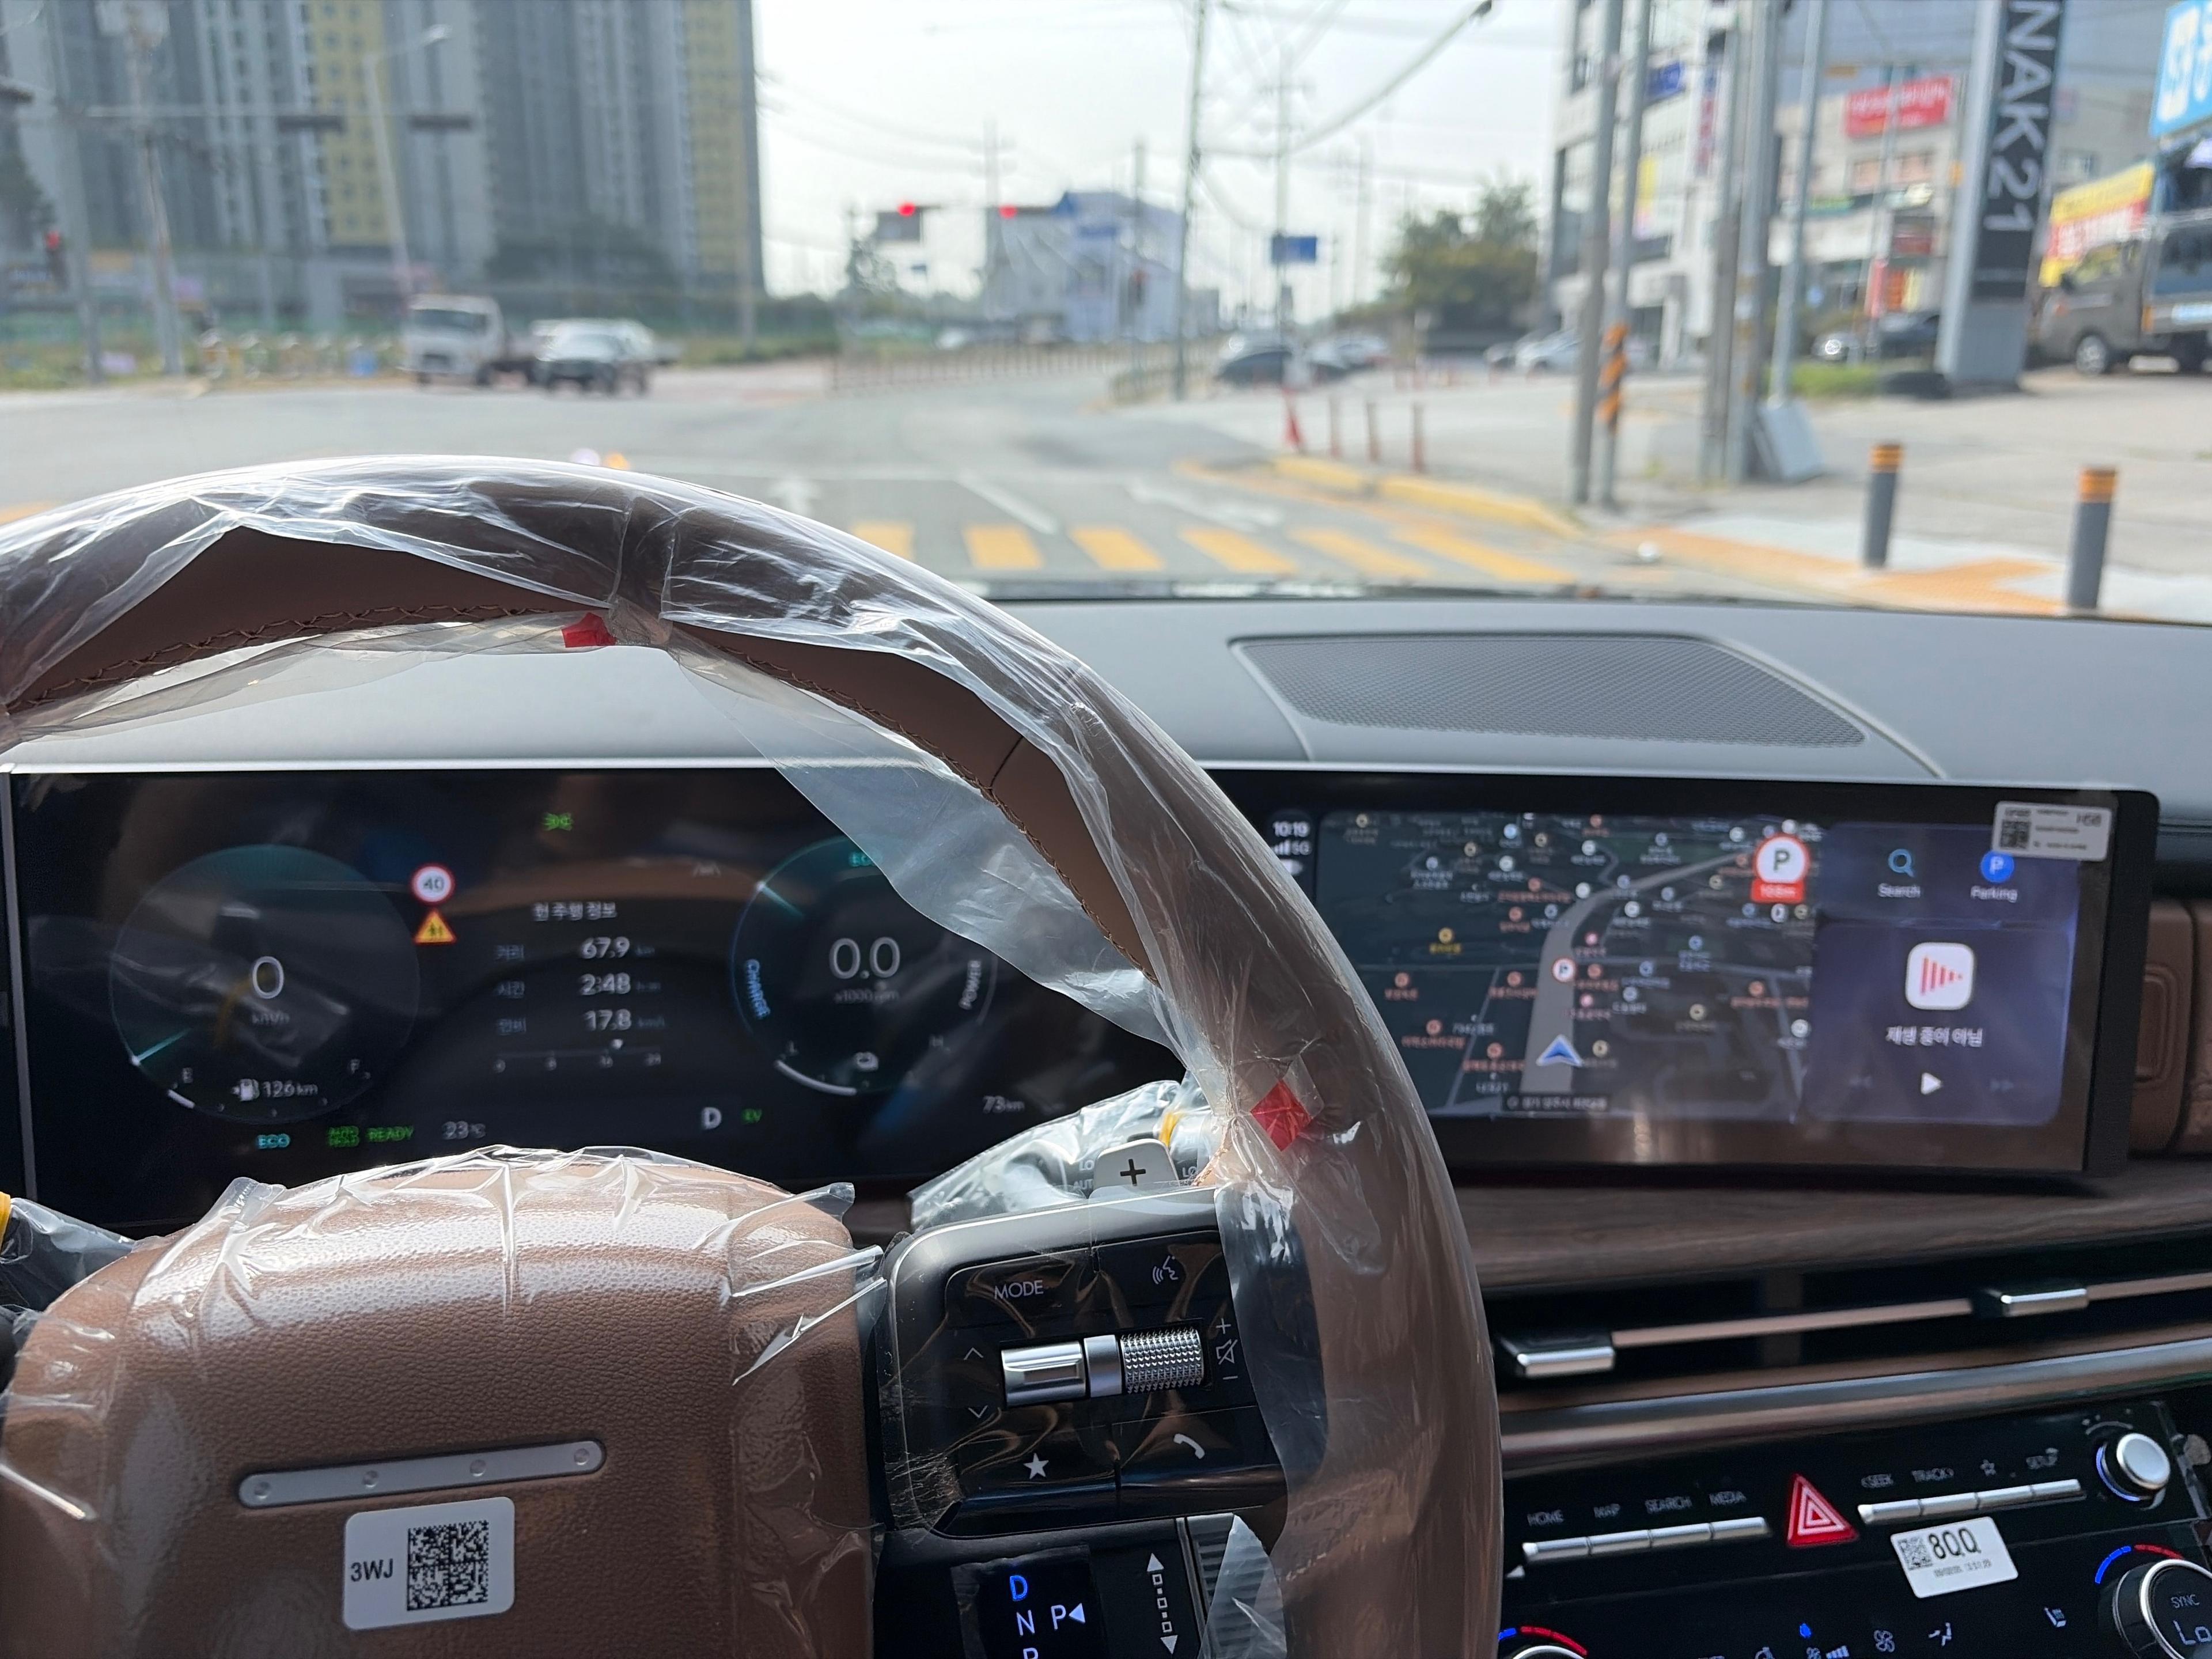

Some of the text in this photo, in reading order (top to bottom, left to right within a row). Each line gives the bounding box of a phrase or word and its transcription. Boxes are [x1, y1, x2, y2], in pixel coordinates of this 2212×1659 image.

[1984, 0, 2061, 232] NAK21
[1272, 821, 1310, 838] 10:19
[422, 876, 445, 893] 40
[1877, 882, 1921, 897] Search
[1971, 885, 2018, 903] Parking
[580, 935, 630, 959] 67.9
[829, 937, 900, 979] 0.0
[252, 955, 285, 999] 0
[580, 972, 631, 995] 2:48
[582, 1008, 632, 1031] 17.8
[701, 1107, 722, 1130] D
[256, 1133, 291, 1150] ECO
[366, 1126, 414, 1143] READY
[994, 1279, 1044, 1300] MODE
[1593, 1503, 1621, 1519] MAP
[1645, 1496, 1693, 1514] SEARCH
[1527, 1509, 1565, 1527] HOME
[350, 1558, 394, 1582] 3WJ
[1009, 1574, 1028, 1601] D
[2171, 1593, 2200, 1608] SYNC
[1016, 1609, 1035, 1636] N
[1050, 1604, 1067, 1630] P
